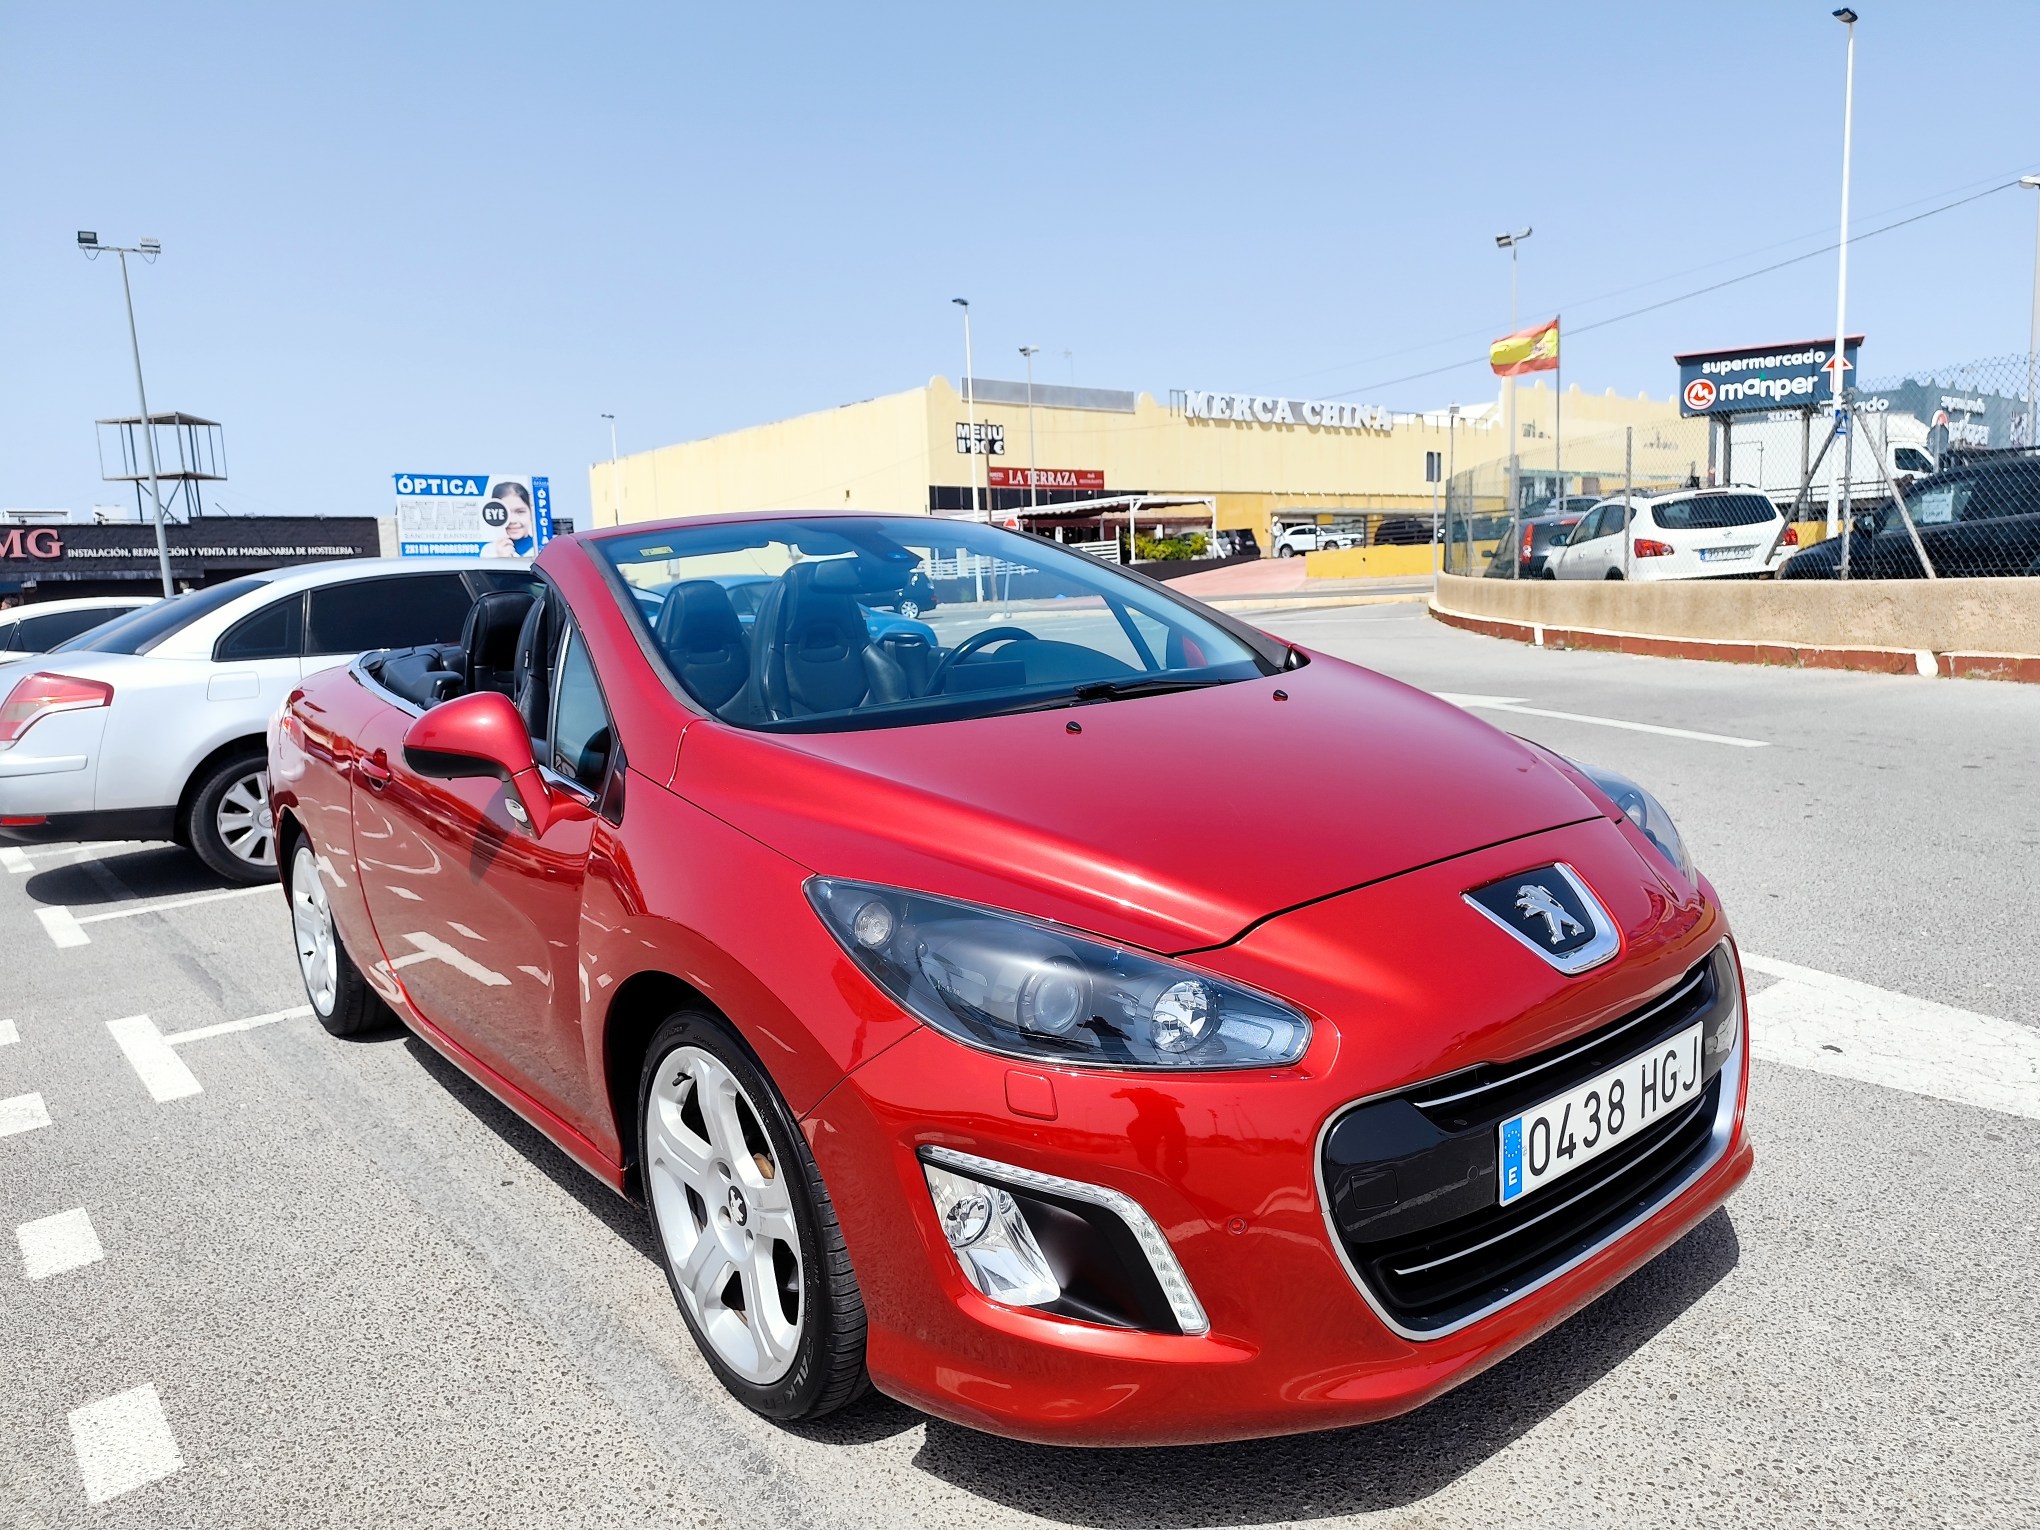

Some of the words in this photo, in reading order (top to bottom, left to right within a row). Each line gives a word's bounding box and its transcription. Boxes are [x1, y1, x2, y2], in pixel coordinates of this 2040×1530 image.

[1702, 348, 1826, 375] supermercado
[1719, 375, 1819, 402] manper
[1184, 390, 1295, 424] MERCA
[1302, 400, 1393, 431] CHINA
[994, 441, 1004, 454] €
[397, 475, 479, 495] ÓPTICA
[1009, 470, 1024, 485] LA
[1026, 470, 1077, 486] TERRAZA
[485, 508, 505, 520] EYE
[68, 547, 131, 558] INSTALACIÓN,
[199, 547, 227, 557] VENTA
[227, 547, 238, 556] DE
[296, 547, 307, 556] DE
[421, 544, 431, 554] EN
[432, 544, 479, 554] PROGRESIVOS
[1528, 1078, 1625, 1177] 0438
[1640, 1035, 1698, 1119] HGJ
[1508, 1166, 1518, 1186] E
